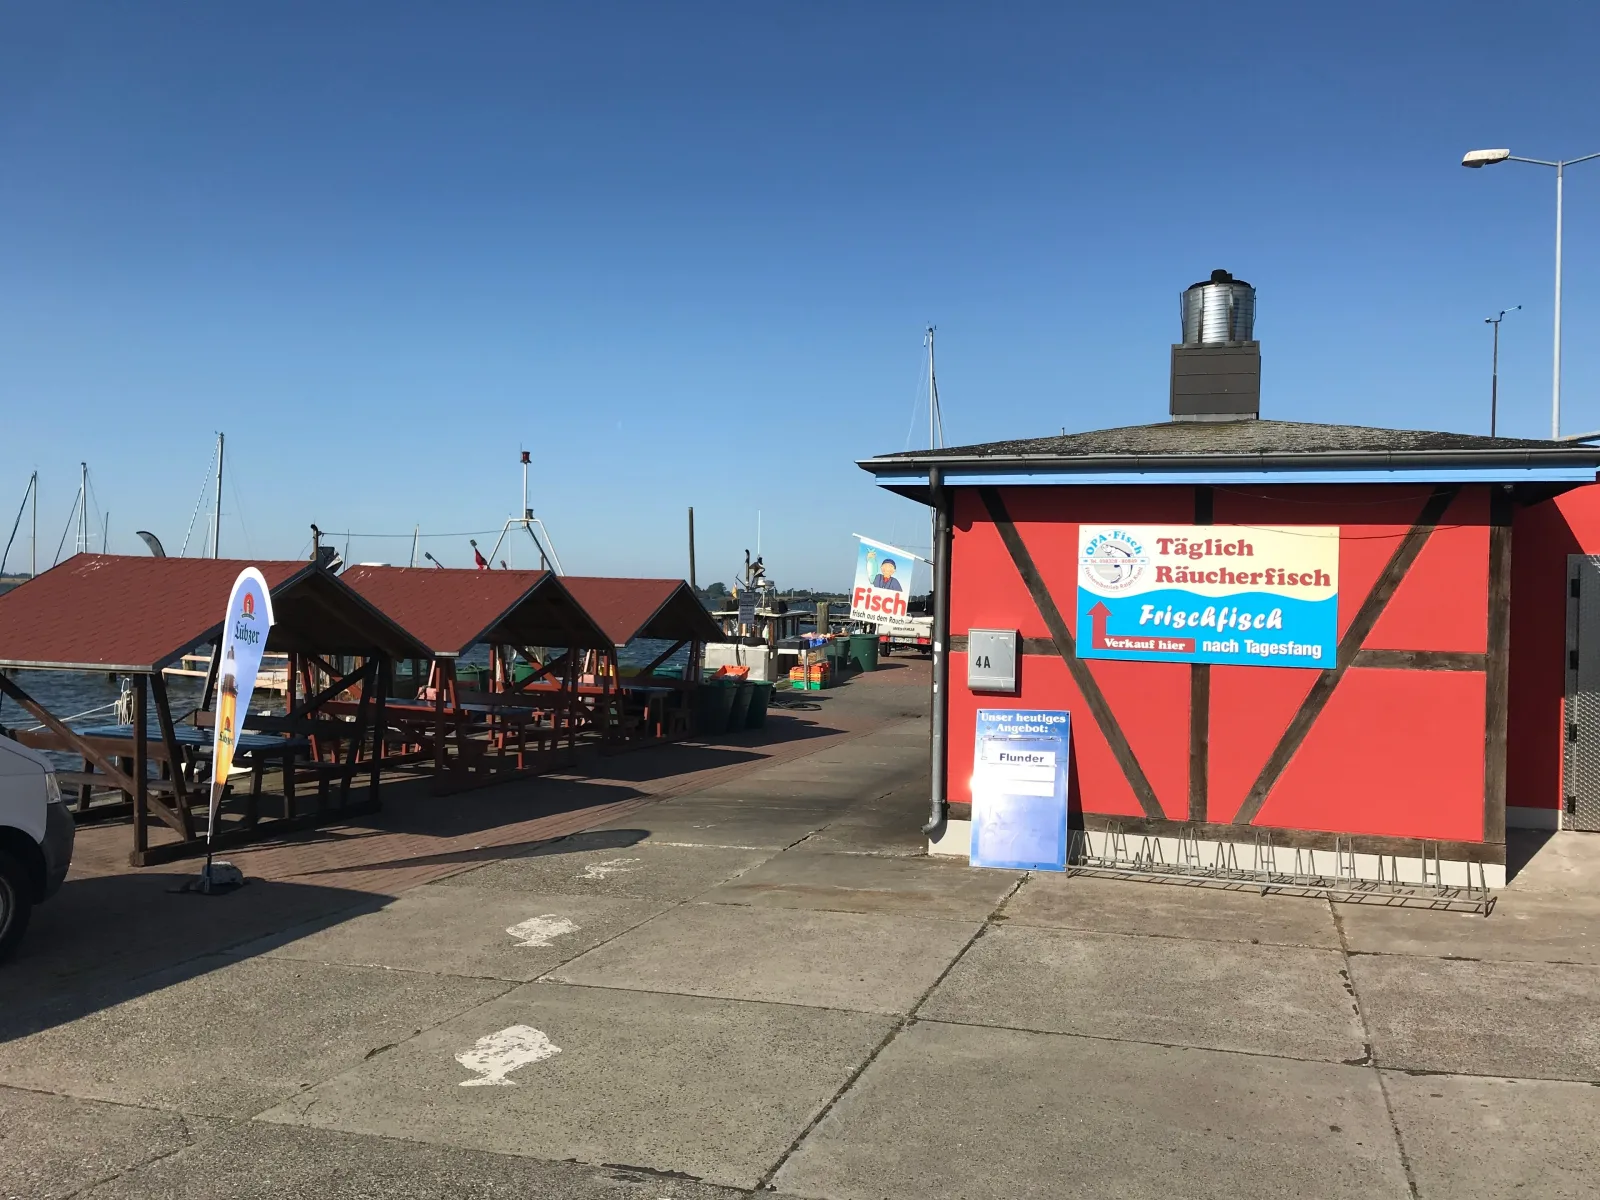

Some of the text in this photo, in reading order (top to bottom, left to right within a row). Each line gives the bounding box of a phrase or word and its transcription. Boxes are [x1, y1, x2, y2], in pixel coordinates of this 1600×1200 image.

[1156, 537, 1254, 560] Täglich
[1155, 565, 1332, 587] Räucherfisch
[853, 586, 907, 617] Fisch
[866, 613, 876, 621] aus
[876, 614, 888, 622] dem
[889, 616, 905, 625] Rauch
[1139, 604, 1284, 633] Frischfisch
[234, 620, 260, 646] Lübzer
[1104, 637, 1186, 651] Verkauf hier
[1202, 638, 1323, 660] nach Tagesfang
[981, 713, 1066, 724] Unser heutiges
[996, 724, 1049, 734] Angebot:
[999, 753, 1045, 763] Flunder
